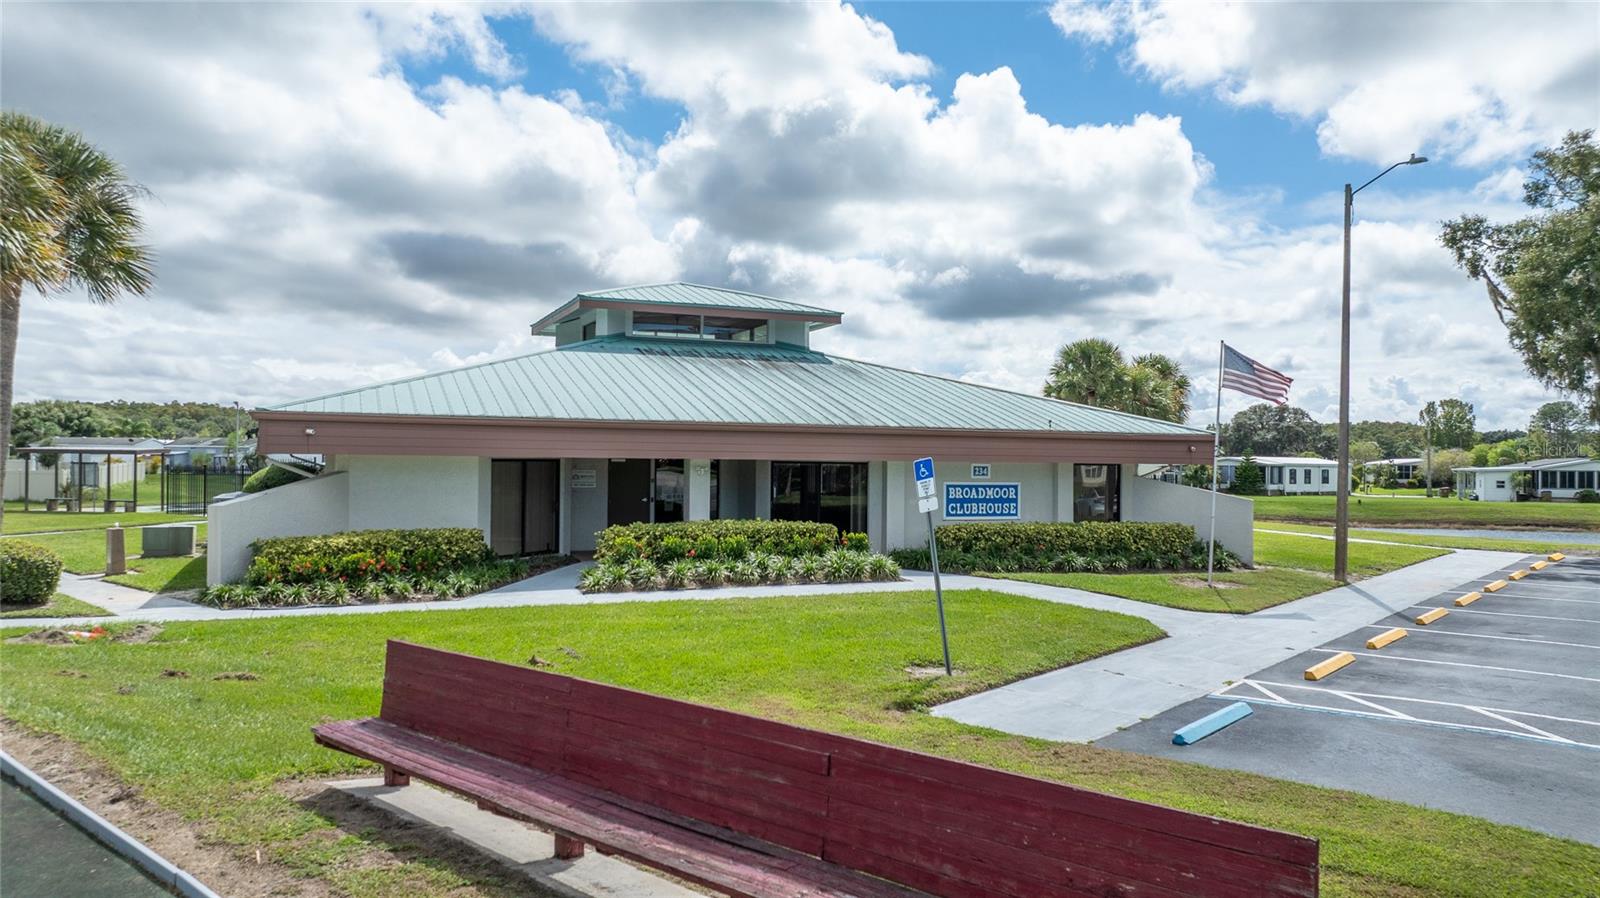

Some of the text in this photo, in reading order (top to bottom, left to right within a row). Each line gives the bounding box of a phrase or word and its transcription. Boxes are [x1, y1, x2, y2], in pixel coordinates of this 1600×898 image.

[974, 467, 988, 475] 234
[948, 487, 1017, 499] BROADMOOR
[948, 503, 1017, 515] CLUBHOUSE
